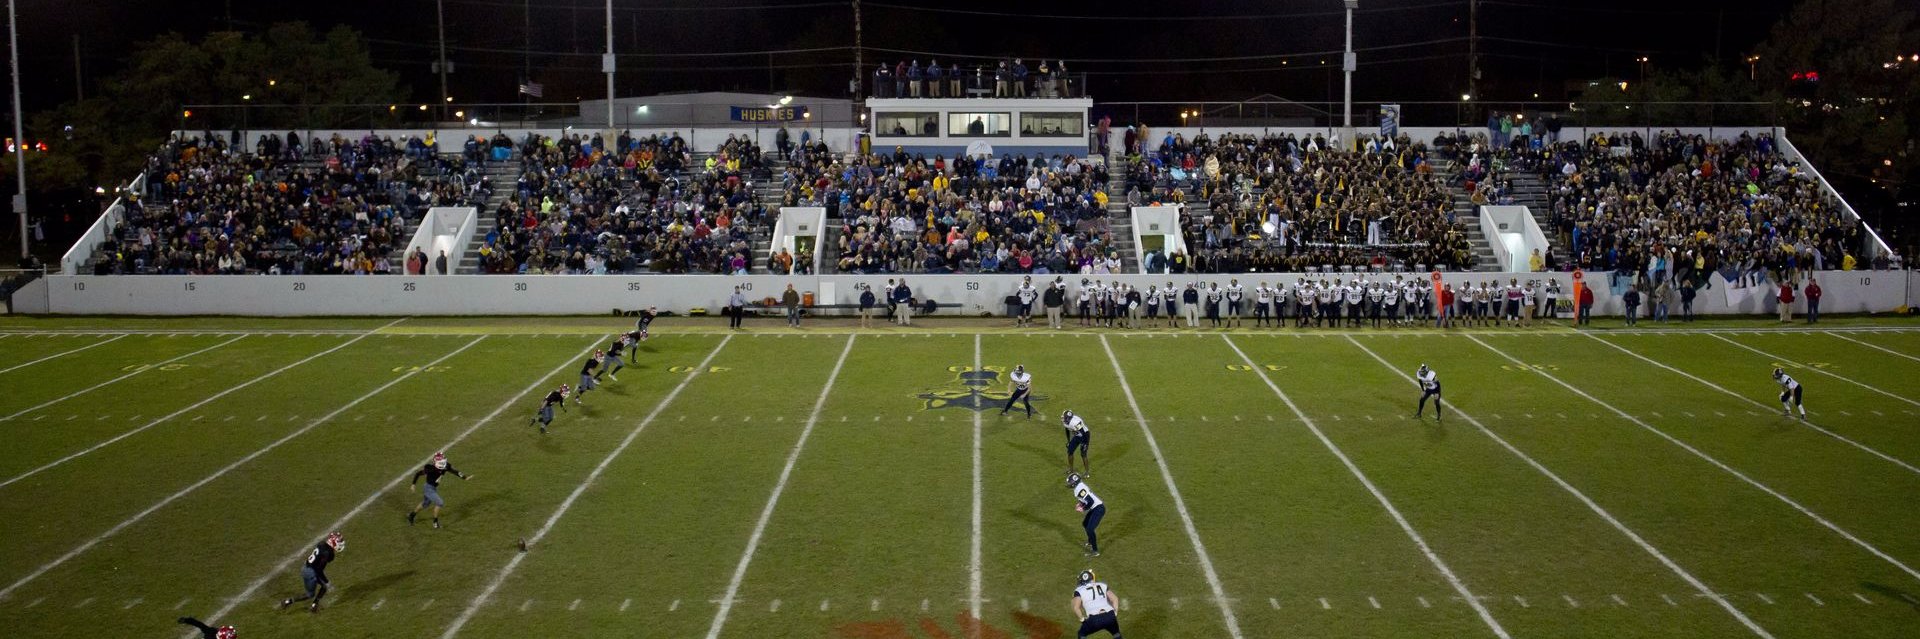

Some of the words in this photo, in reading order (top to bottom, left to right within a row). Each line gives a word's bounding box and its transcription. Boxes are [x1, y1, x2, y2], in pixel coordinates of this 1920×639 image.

[1860, 277, 1871, 286] 10
[74, 282, 85, 291] 10
[184, 282, 197, 291] 15
[293, 282, 306, 291] 20
[403, 282, 416, 291] 25
[514, 282, 528, 291] 30
[627, 282, 641, 291] 35
[740, 282, 752, 291] 40
[966, 282, 979, 291] 50
[308, 548, 319, 563] 6
[1086, 585, 1105, 600] 74
